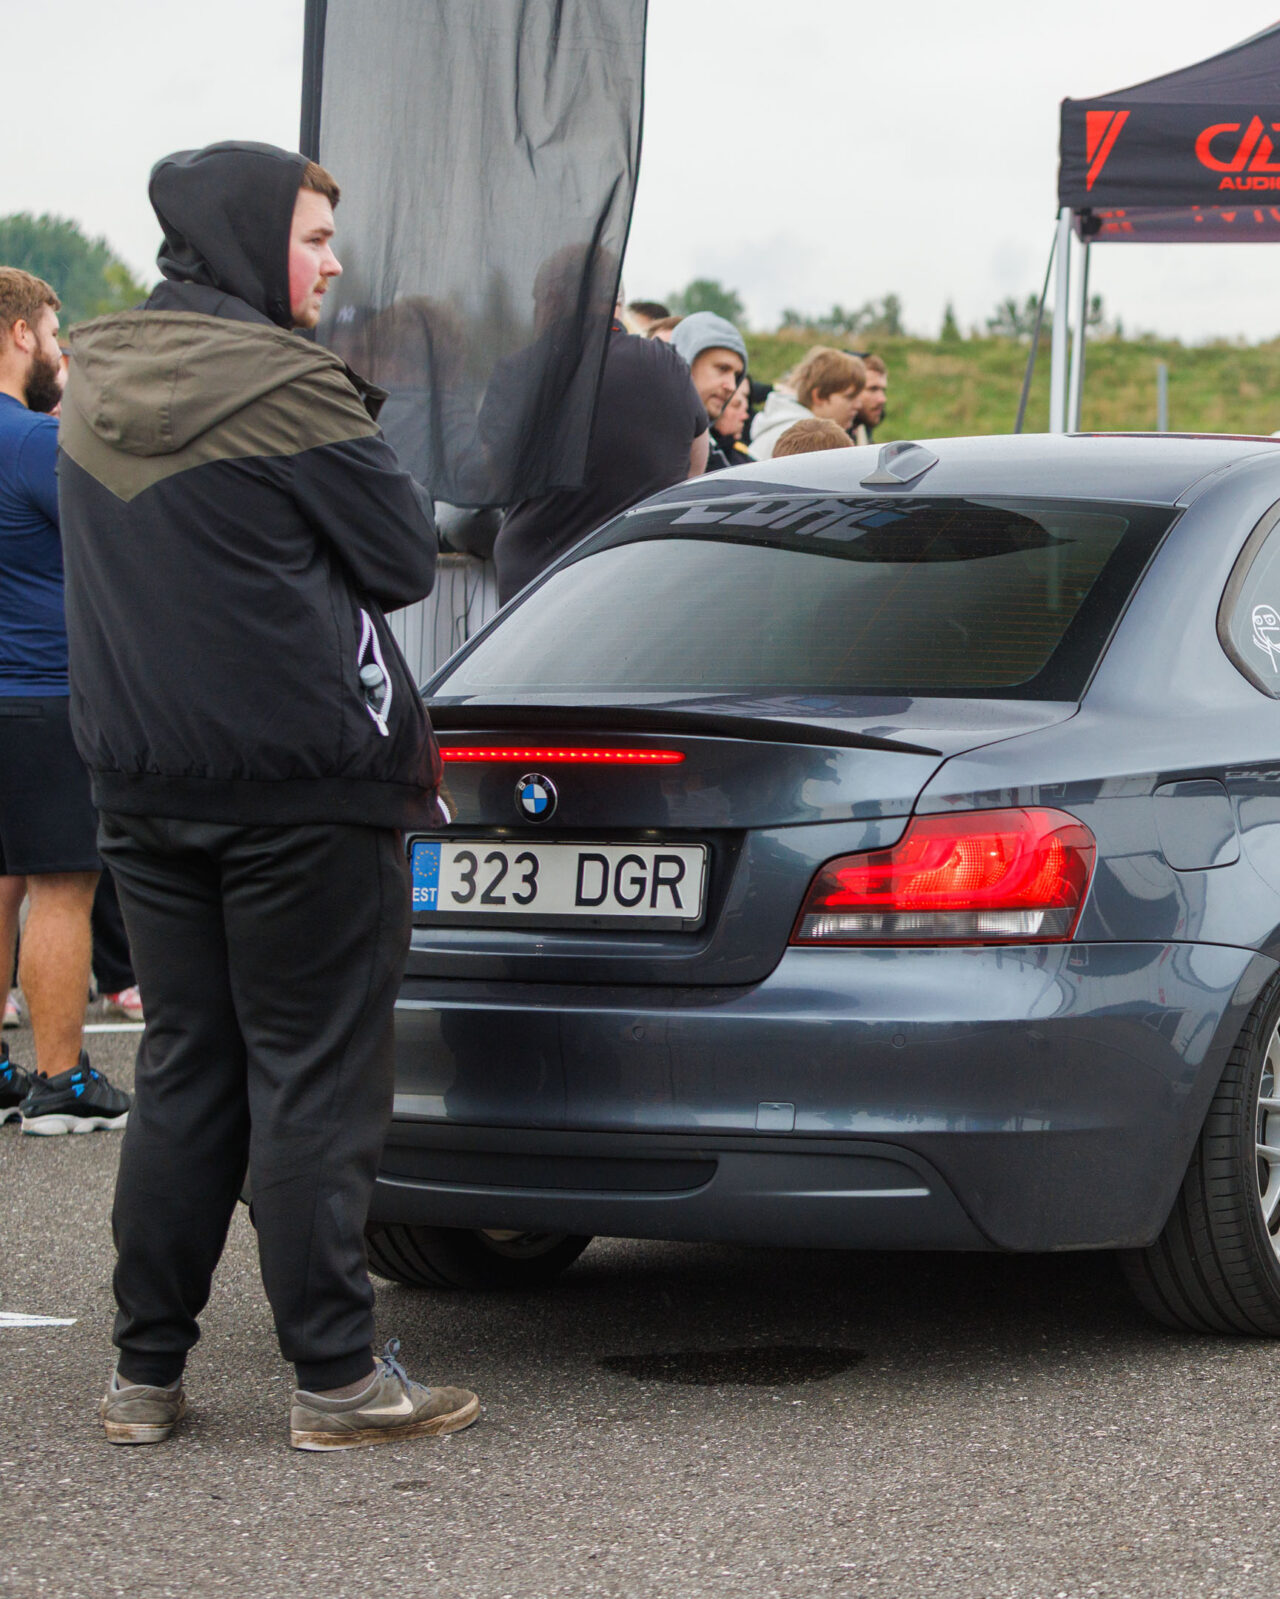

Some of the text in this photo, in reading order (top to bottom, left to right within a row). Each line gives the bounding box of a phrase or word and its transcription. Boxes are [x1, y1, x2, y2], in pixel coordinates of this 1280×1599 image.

[412, 887, 437, 902] EST
[452, 850, 686, 909] 323 DGR
